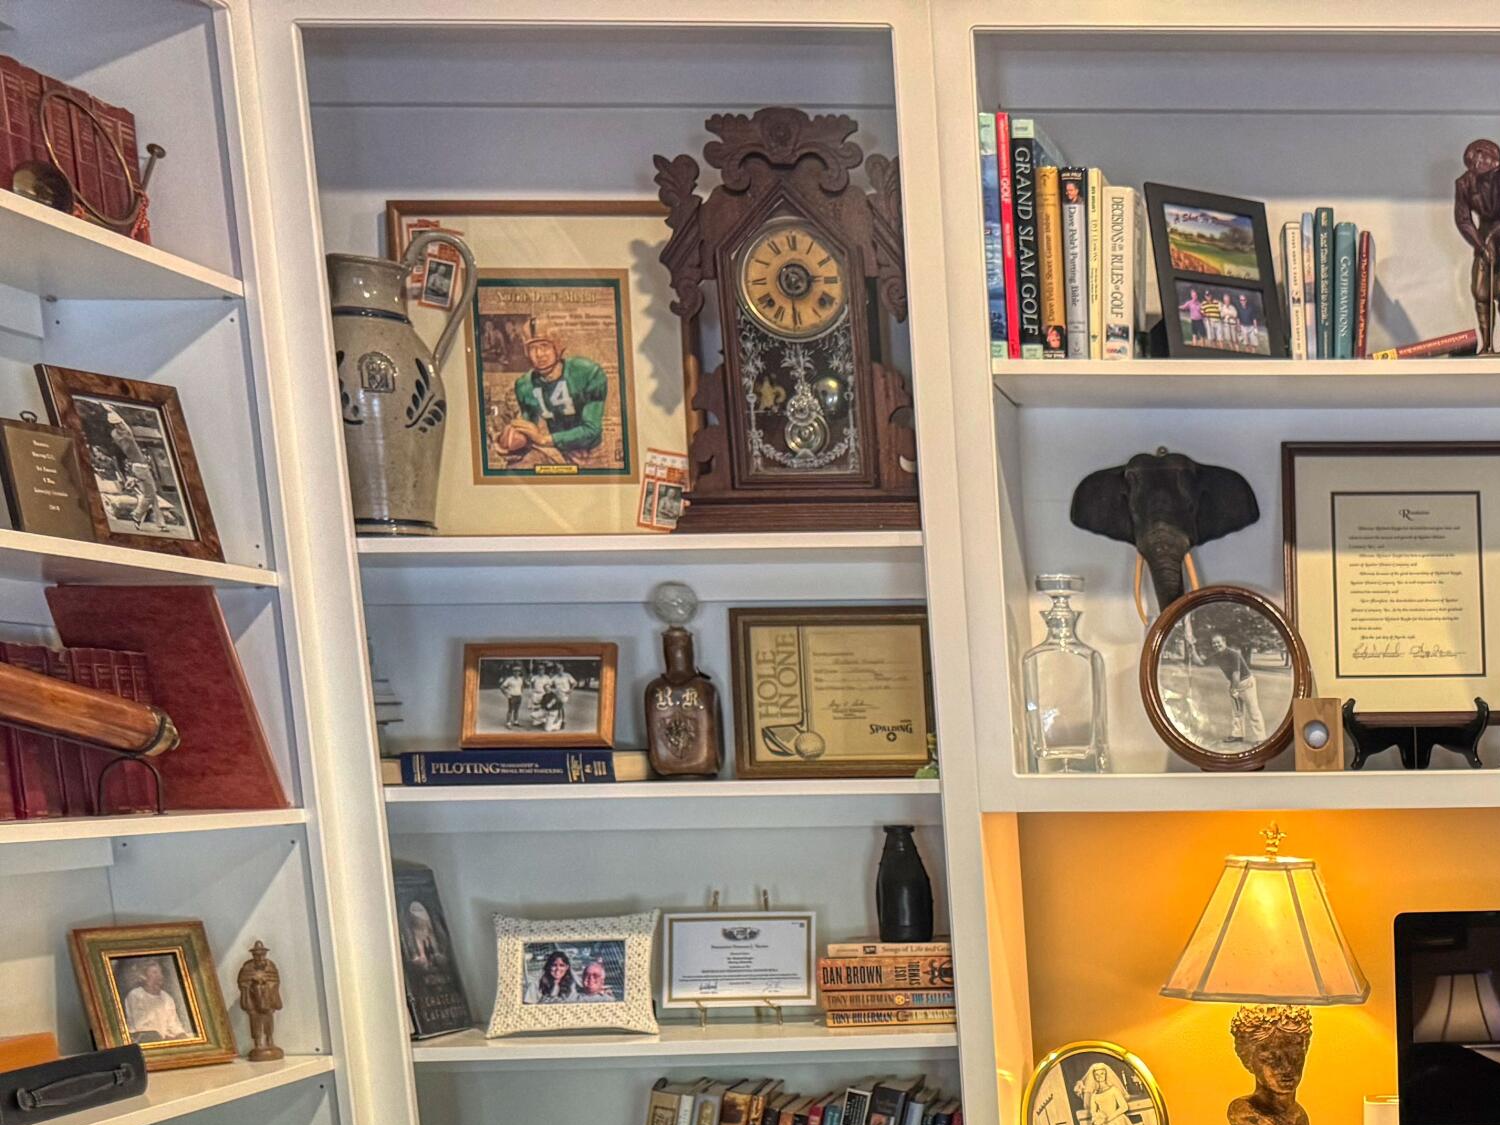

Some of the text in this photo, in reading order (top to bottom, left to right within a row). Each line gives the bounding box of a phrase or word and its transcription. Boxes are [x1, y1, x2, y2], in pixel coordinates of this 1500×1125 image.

[1067, 207, 1078, 226] Dave
[1013, 147, 1039, 335] GRAND SLAM GOLF
[1110, 197, 1124, 318] DECISIONS RULES GOLF
[1070, 286, 1081, 306] Bible
[532, 380, 576, 419] 14
[755, 650, 777, 720] HOLE
[775, 633, 799, 718] IN ONE
[869, 723, 912, 735] SPALDING
[431, 762, 500, 774] PILOTING
[822, 965, 883, 984] DAN BROWN
[894, 965, 907, 982] LOST
[831, 1011, 893, 1024] TONY HILLERMAN
